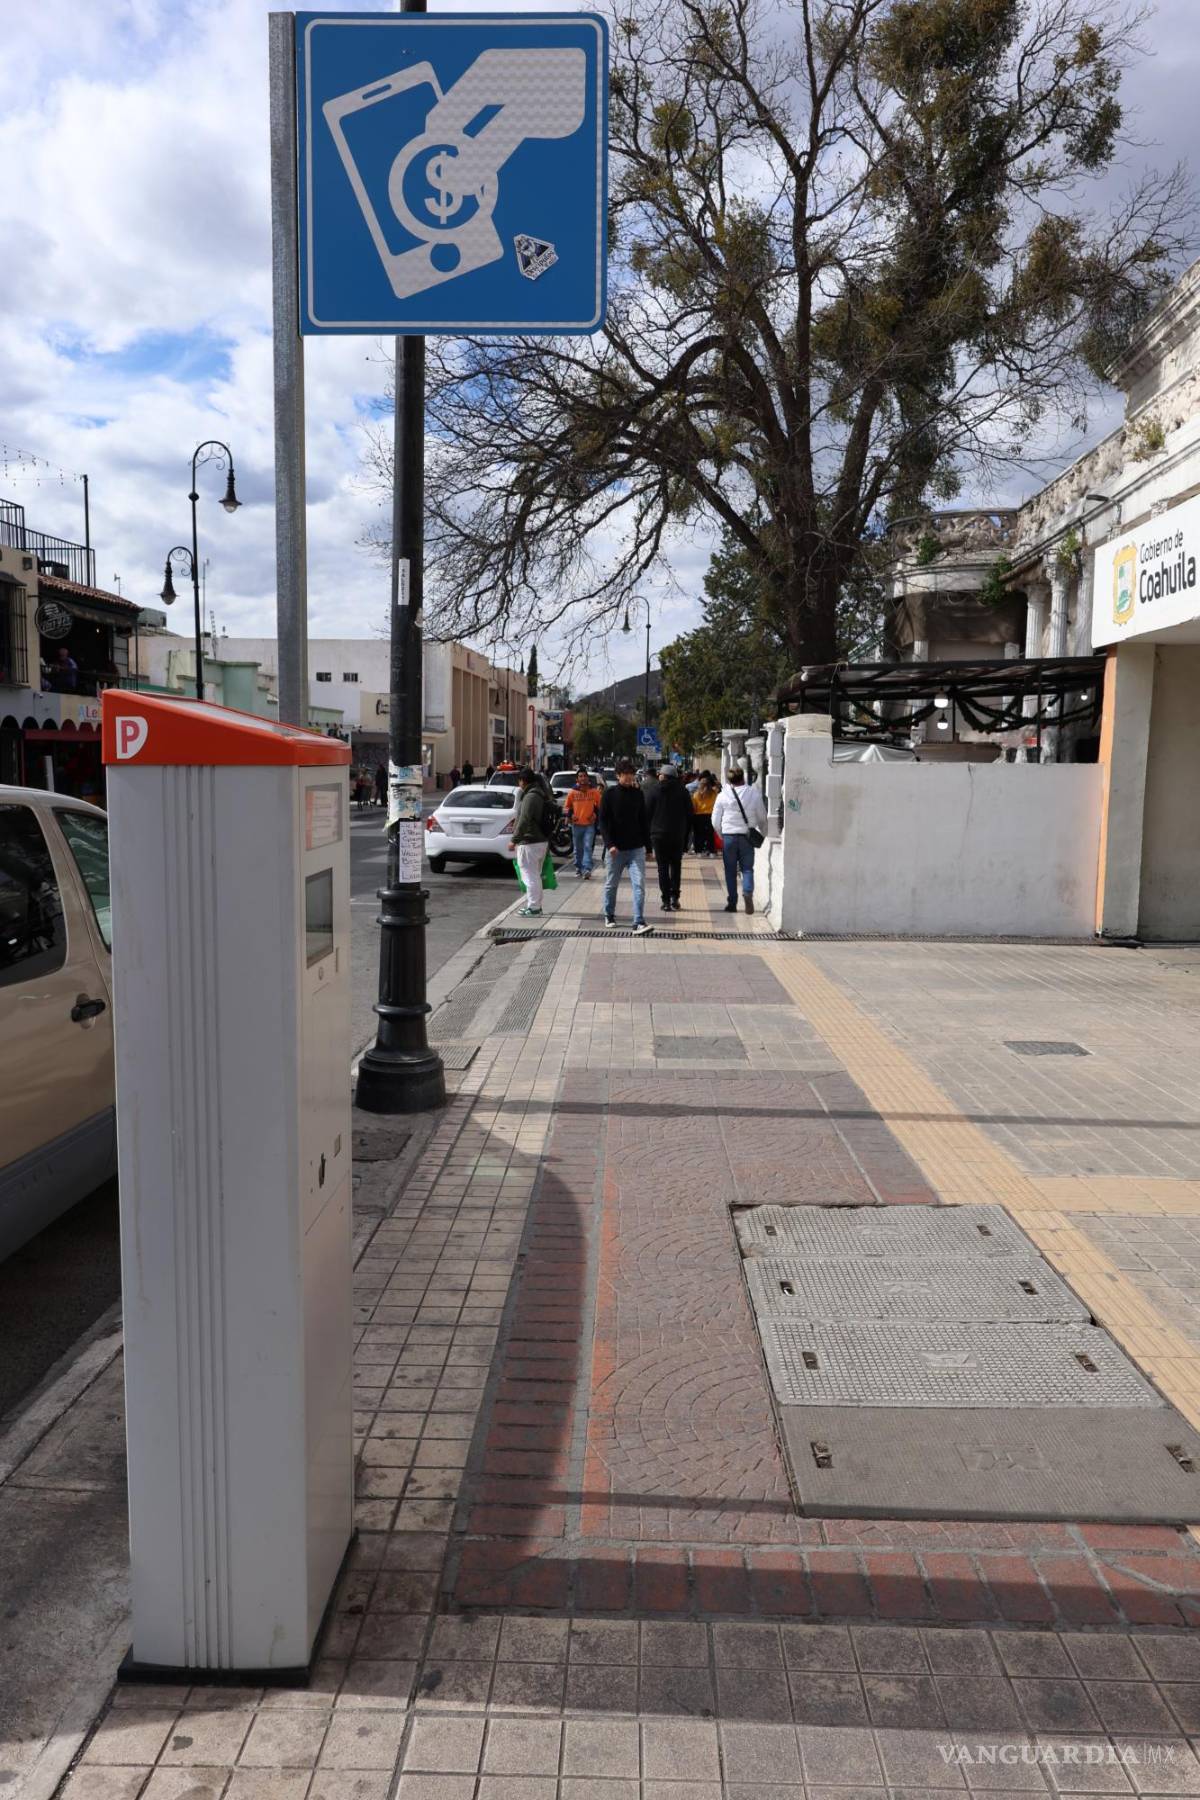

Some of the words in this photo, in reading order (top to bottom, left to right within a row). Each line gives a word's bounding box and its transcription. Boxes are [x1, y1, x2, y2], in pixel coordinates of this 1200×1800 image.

[1140, 536, 1173, 564] Gobierno
[1174, 528, 1184, 549] de
[1139, 551, 1196, 604] Coahuila
[120, 719, 141, 754] P
